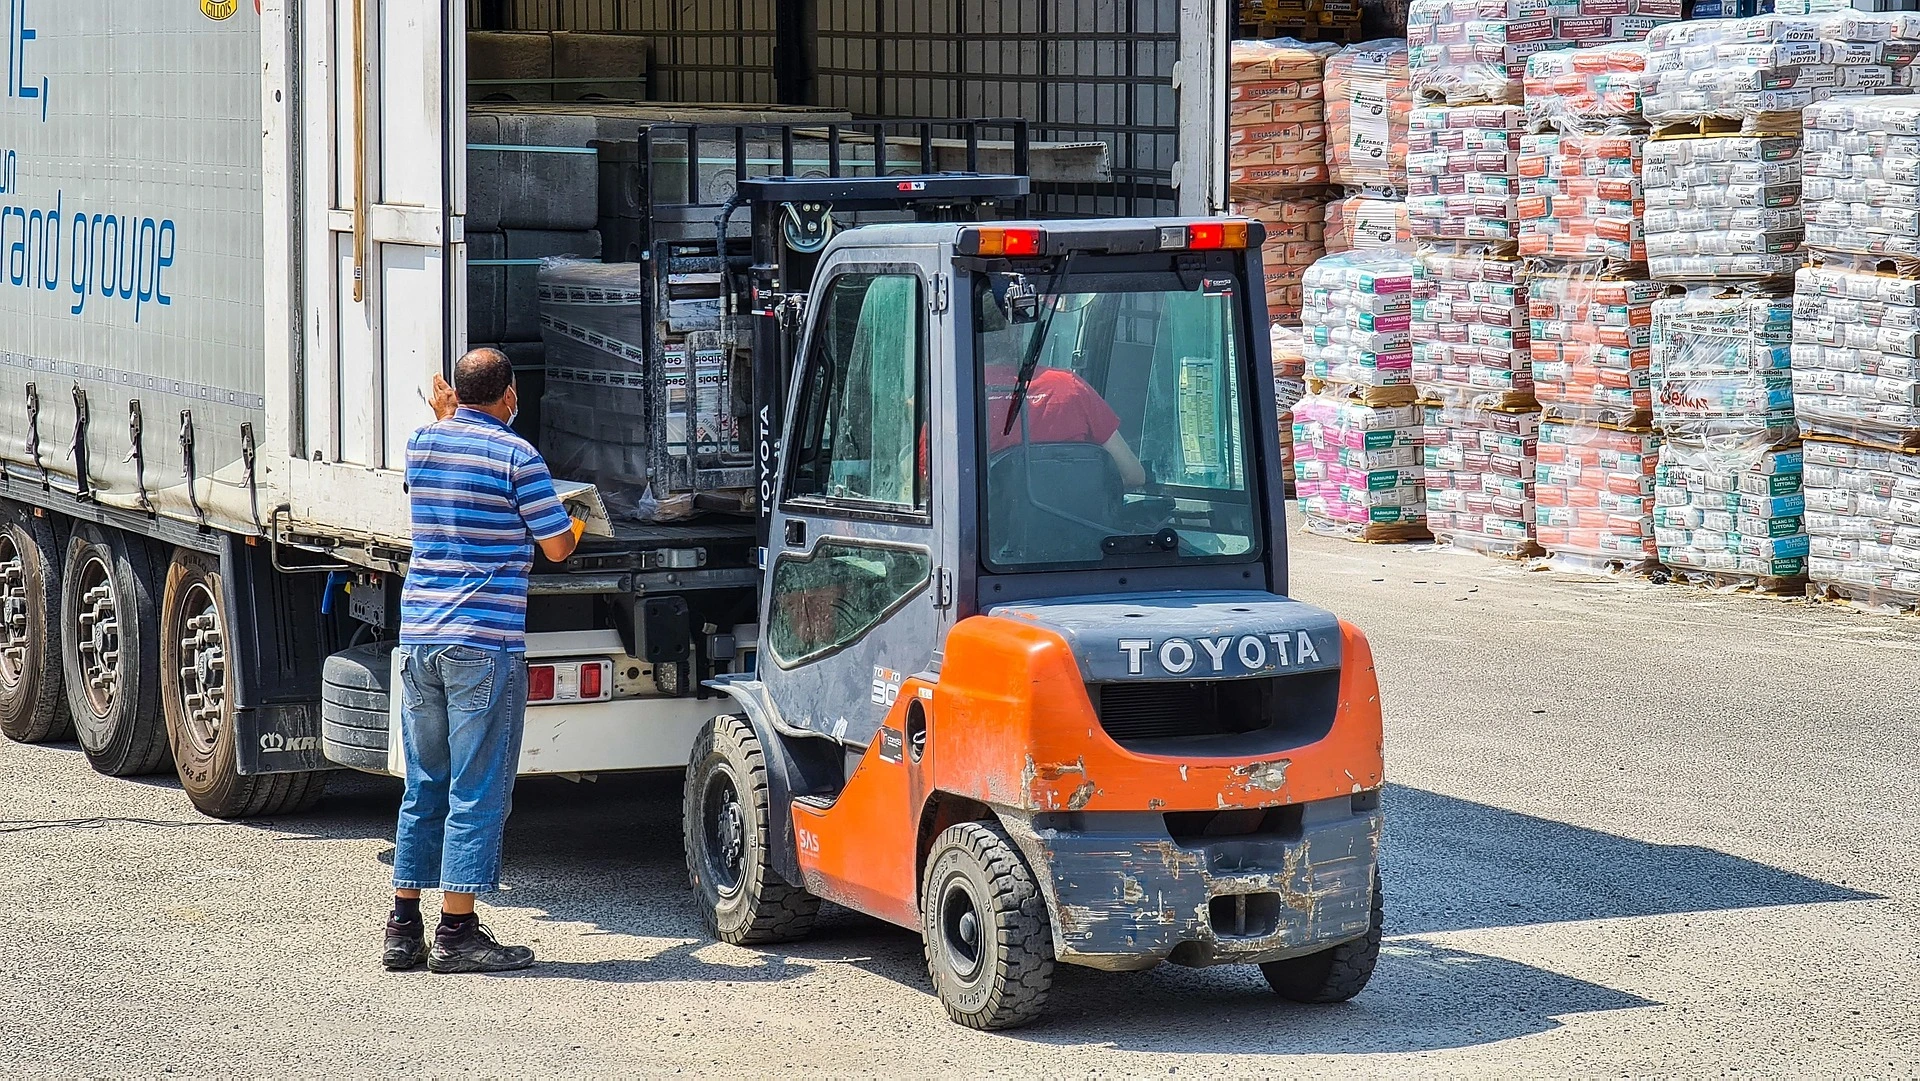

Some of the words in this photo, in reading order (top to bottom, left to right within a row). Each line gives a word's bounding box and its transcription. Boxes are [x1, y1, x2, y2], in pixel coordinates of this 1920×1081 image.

[1856, 79, 1886, 87] MOYEN
[71, 212, 175, 323] groupe
[760, 404, 771, 518] TOYOTA
[1773, 524, 1796, 532] LITTORAL
[1118, 629, 1321, 675] TOYOTA
[871, 679, 900, 707] 30
